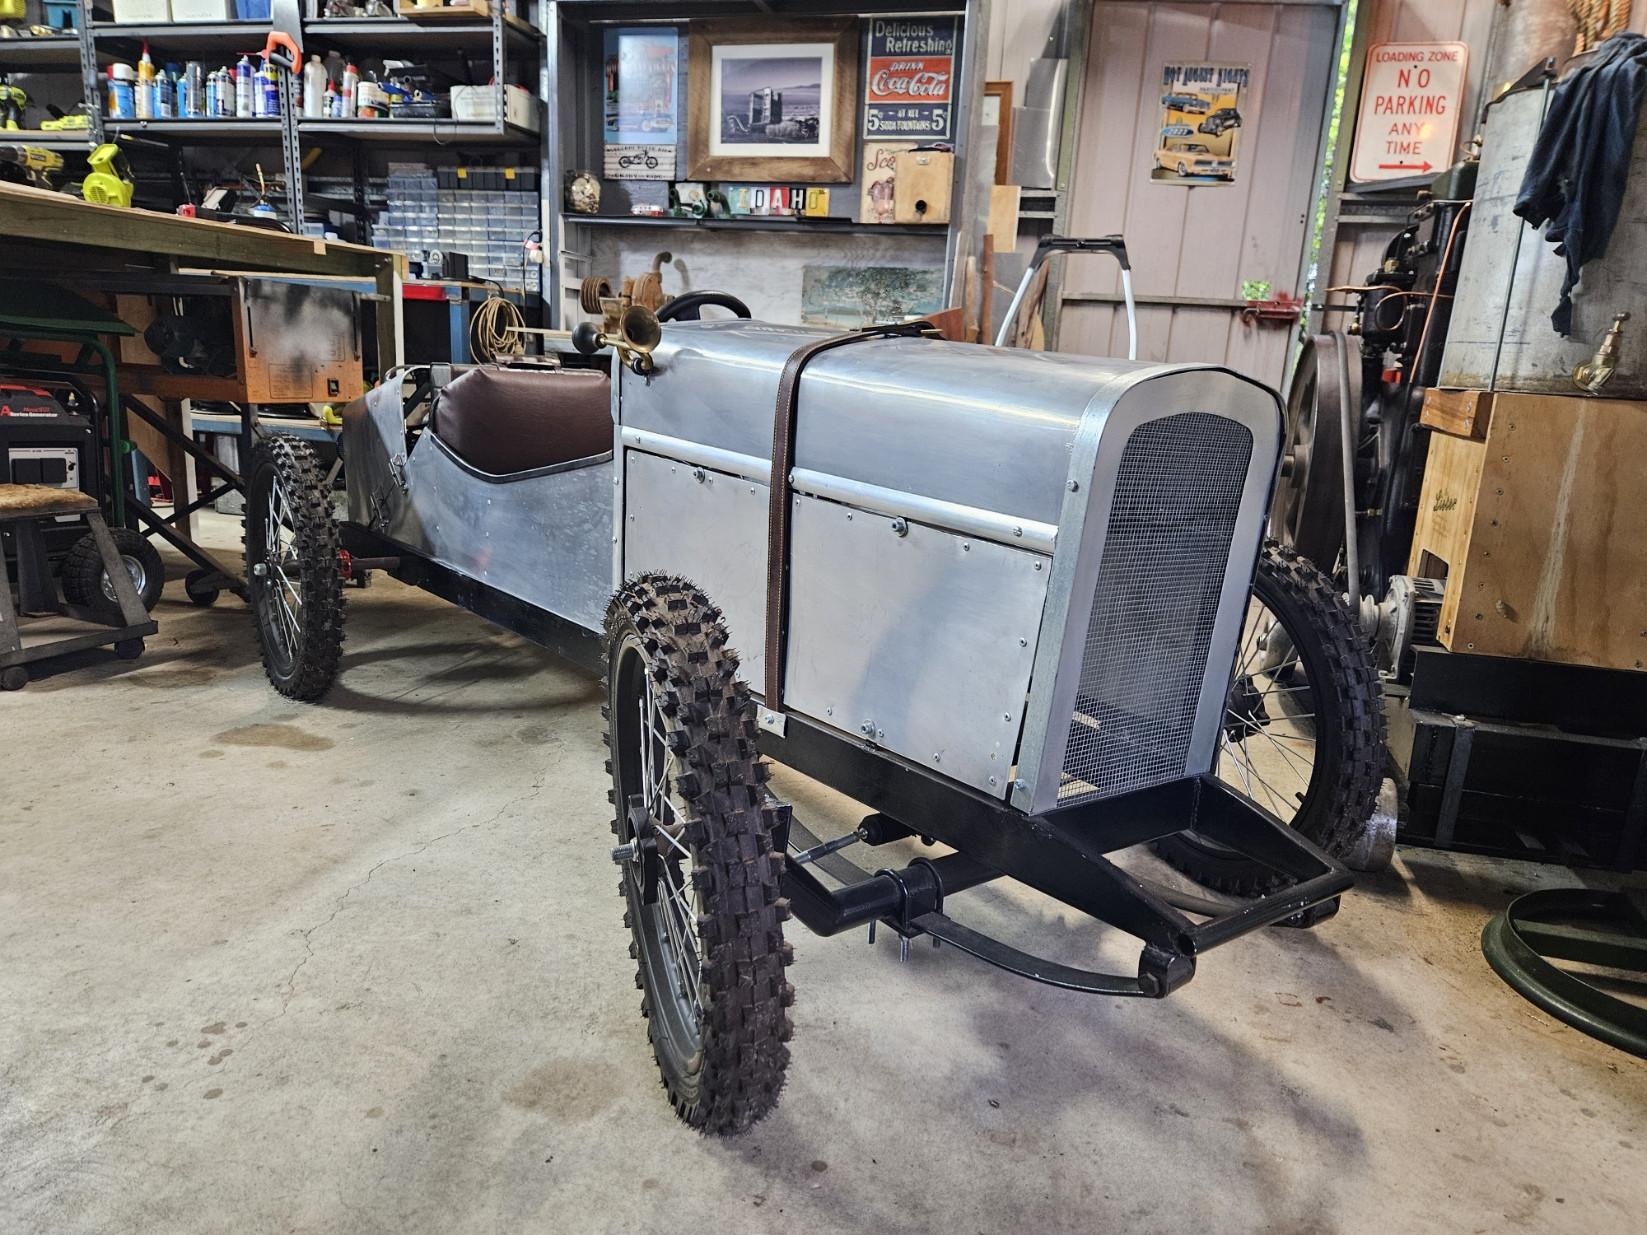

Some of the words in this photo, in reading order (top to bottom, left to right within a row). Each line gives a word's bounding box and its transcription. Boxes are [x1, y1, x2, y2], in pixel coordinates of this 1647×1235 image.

[875, 21, 934, 37] Delicious
[886, 37, 953, 55] Refreshing
[1376, 52, 1424, 63] LOADING
[1428, 51, 1459, 62] ZONE
[889, 61, 925, 71] DRINK
[1397, 69, 1431, 88] NO
[1374, 95, 1447, 115] PARKING
[1386, 141, 1422, 155] TIME
[739, 187, 819, 210] IDAHO
